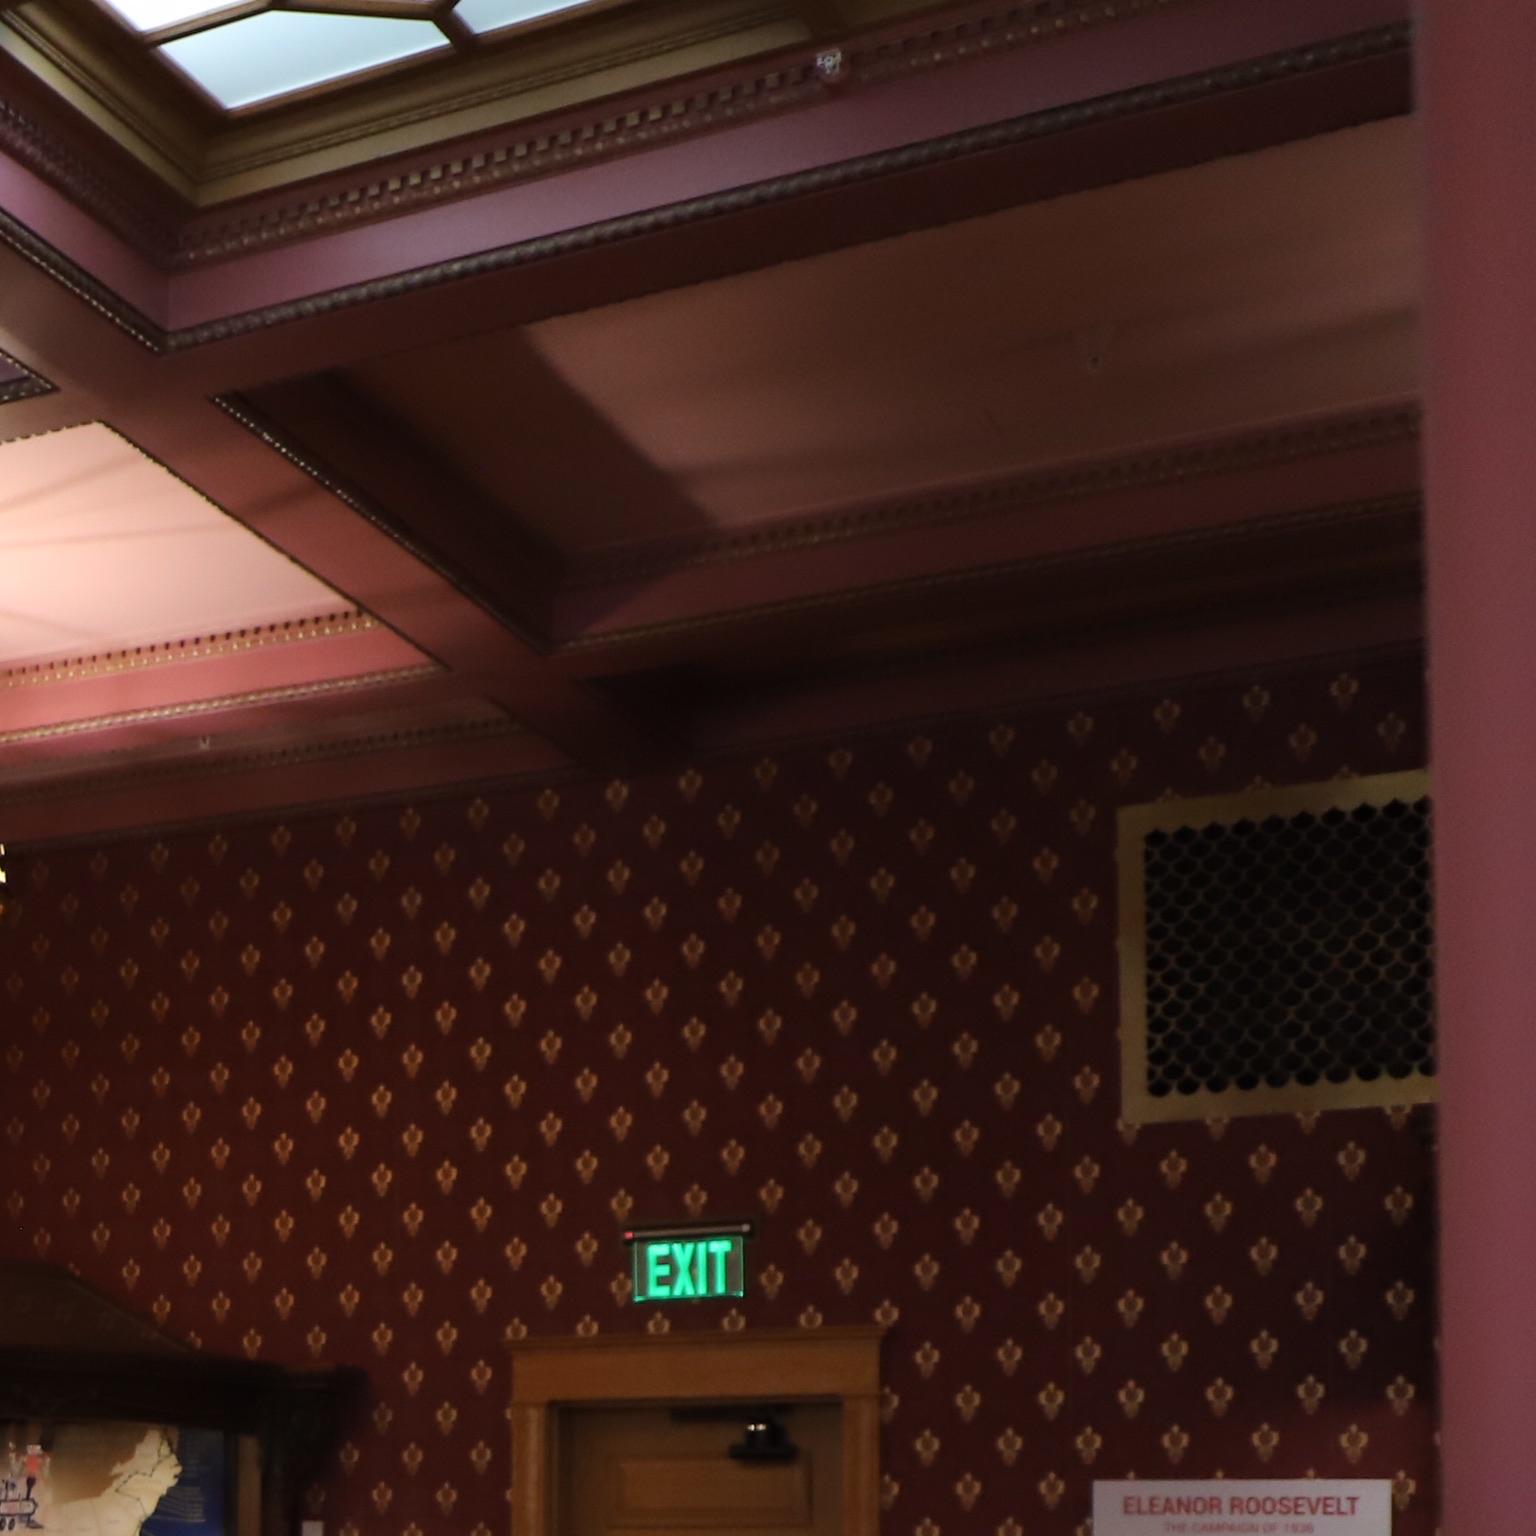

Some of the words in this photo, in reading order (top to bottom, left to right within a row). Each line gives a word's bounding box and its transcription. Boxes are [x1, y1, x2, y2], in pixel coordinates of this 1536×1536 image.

[647, 1240, 732, 1297] EXIT
[1123, 1496, 1222, 1516] ELEANOR
[1230, 1496, 1359, 1516] ROOSEVELT
